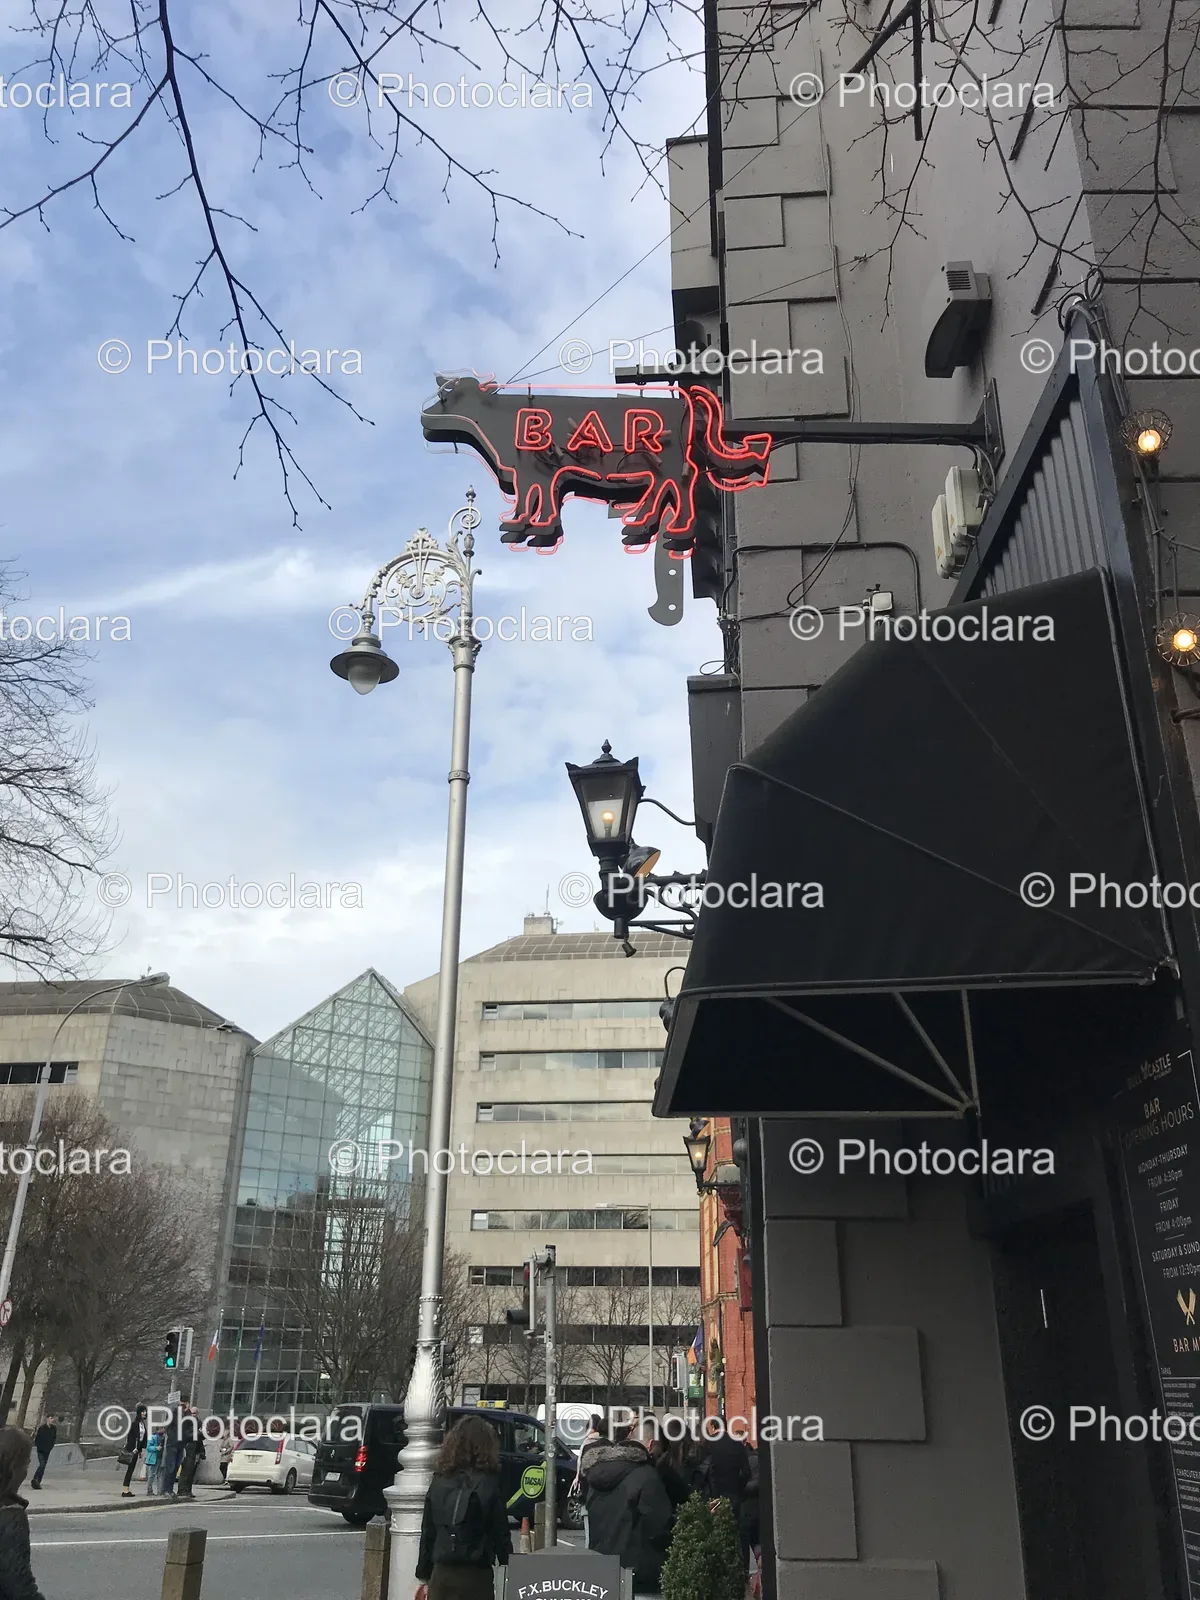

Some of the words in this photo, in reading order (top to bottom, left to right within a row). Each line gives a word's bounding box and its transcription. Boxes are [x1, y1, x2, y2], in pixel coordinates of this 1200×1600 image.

[515, 407, 664, 453] BAR
[1147, 1053, 1172, 1077] CASTLE
[1143, 1097, 1161, 1119] BAR
[1161, 1102, 1194, 1132] HOURS
[1137, 1143, 1189, 1175] MONDAY-THURSDAY
[1147, 1175, 1163, 1189] FROM
[1159, 1197, 1179, 1213] FRIDAY
[1155, 1218, 1171, 1233] FROM
[1152, 1247, 1178, 1263] SATURDAY
[1178, 1245, 1183, 1256] &
[1162, 1266, 1179, 1280] FROM
[1172, 1337, 1190, 1353] BAR
[518, 1579, 609, 1600] F.X.BUCKLEY
